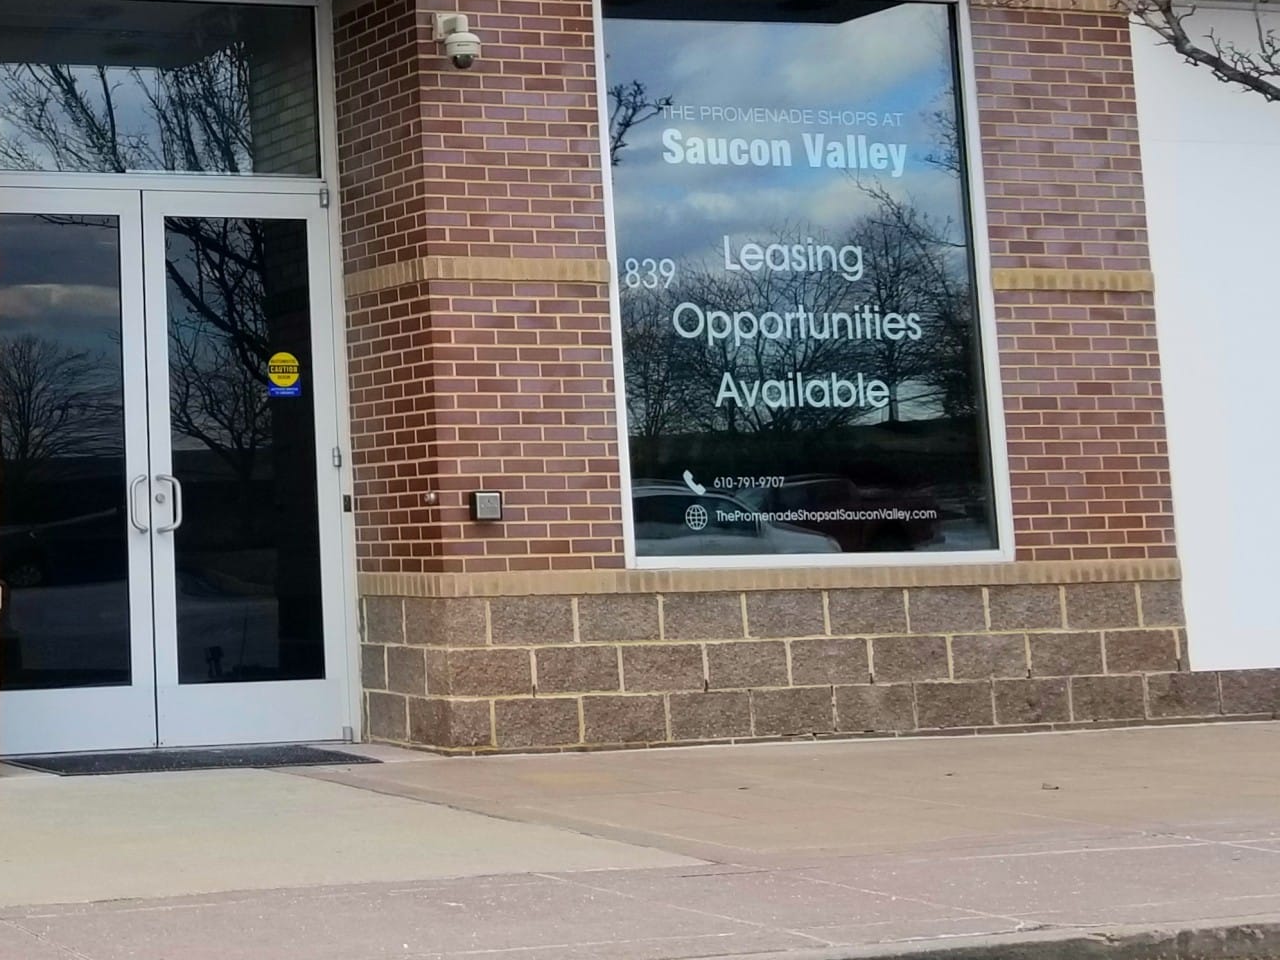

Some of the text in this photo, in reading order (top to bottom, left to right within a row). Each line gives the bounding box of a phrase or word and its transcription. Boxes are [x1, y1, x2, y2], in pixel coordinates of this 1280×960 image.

[661, 105, 905, 128] THE PROMENADE SHOPS AT
[662, 127, 908, 178] Saucon Valley
[625, 257, 677, 290] 839
[723, 235, 864, 282] Leasing
[673, 301, 923, 347] Opportunities
[715, 371, 891, 409] Available
[713, 476, 786, 489] 610-791-9707
[715, 508, 938, 523] ThePromenadeShopsatSauconValley.com
